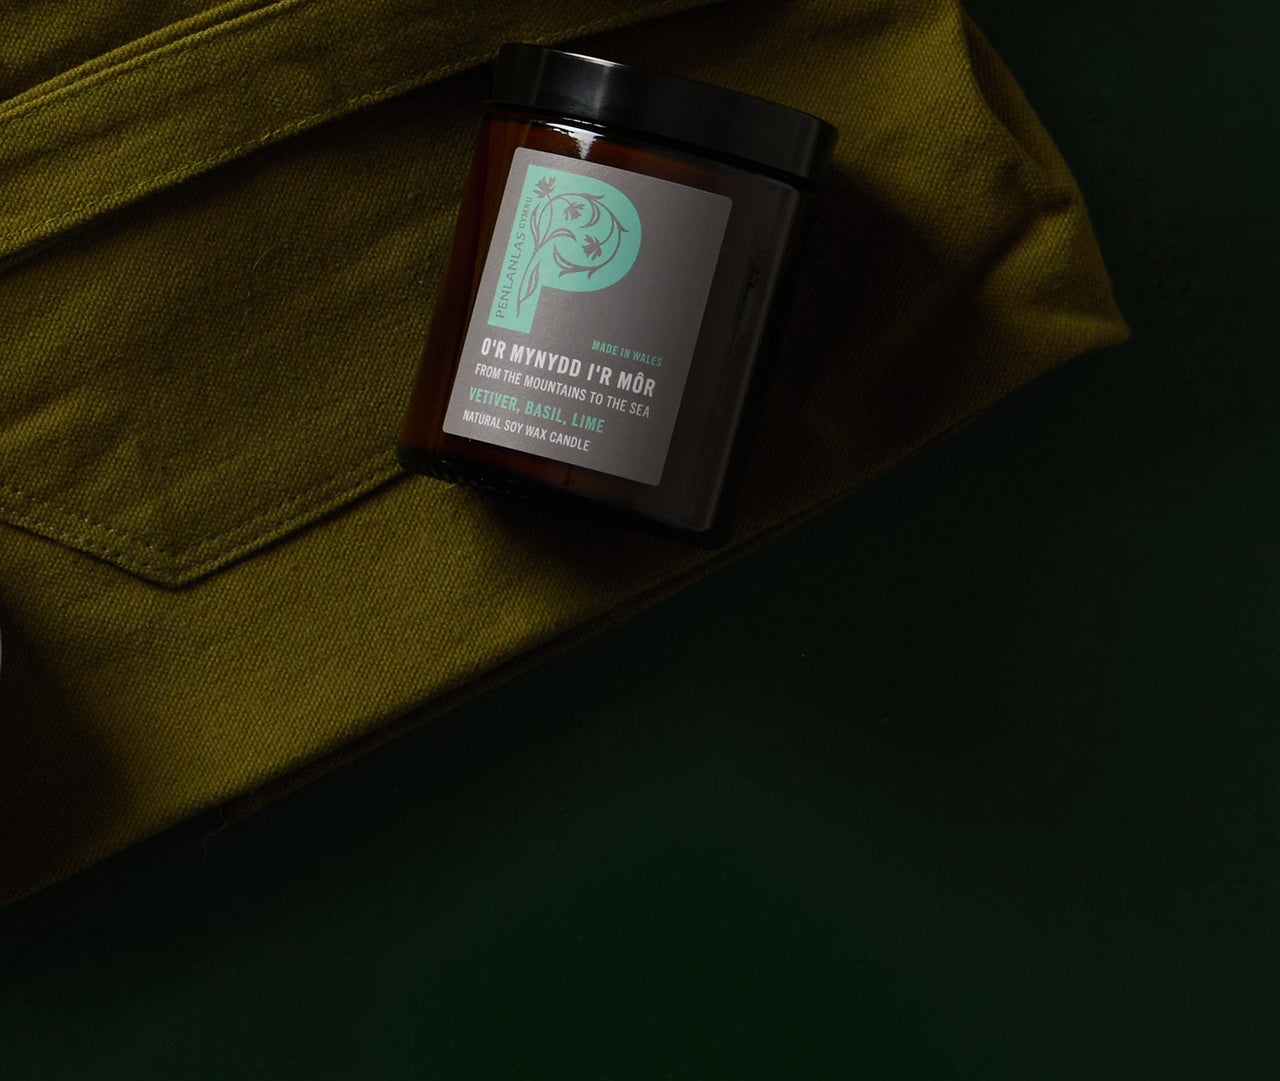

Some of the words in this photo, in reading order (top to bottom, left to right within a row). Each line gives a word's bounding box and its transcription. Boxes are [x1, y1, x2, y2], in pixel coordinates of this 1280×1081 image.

[495, 232, 526, 319] PENLANLAS
[481, 337, 507, 359] O'R
[509, 344, 582, 378] MYNYDD
[587, 363, 613, 386] I'R
[617, 370, 656, 398] MÔR
[592, 340, 619, 356] MADE
[620, 348, 631, 359] IN
[632, 350, 663, 367] WALES
[469, 386, 521, 414] VETIVER,
[525, 400, 567, 426] BASIL,
[571, 412, 606, 434] LIME
[475, 363, 502, 380] FROM
[503, 369, 523, 386] THE
[523, 375, 587, 401] MOUNTAINS
[590, 391, 604, 406] TO
[607, 395, 629, 412] THE
[629, 402, 651, 418] SEA
[463, 409, 501, 430] NATURAL
[504, 419, 525, 434] SOY
[525, 425, 548, 441] WAX
[549, 431, 591, 452] CANDLE
